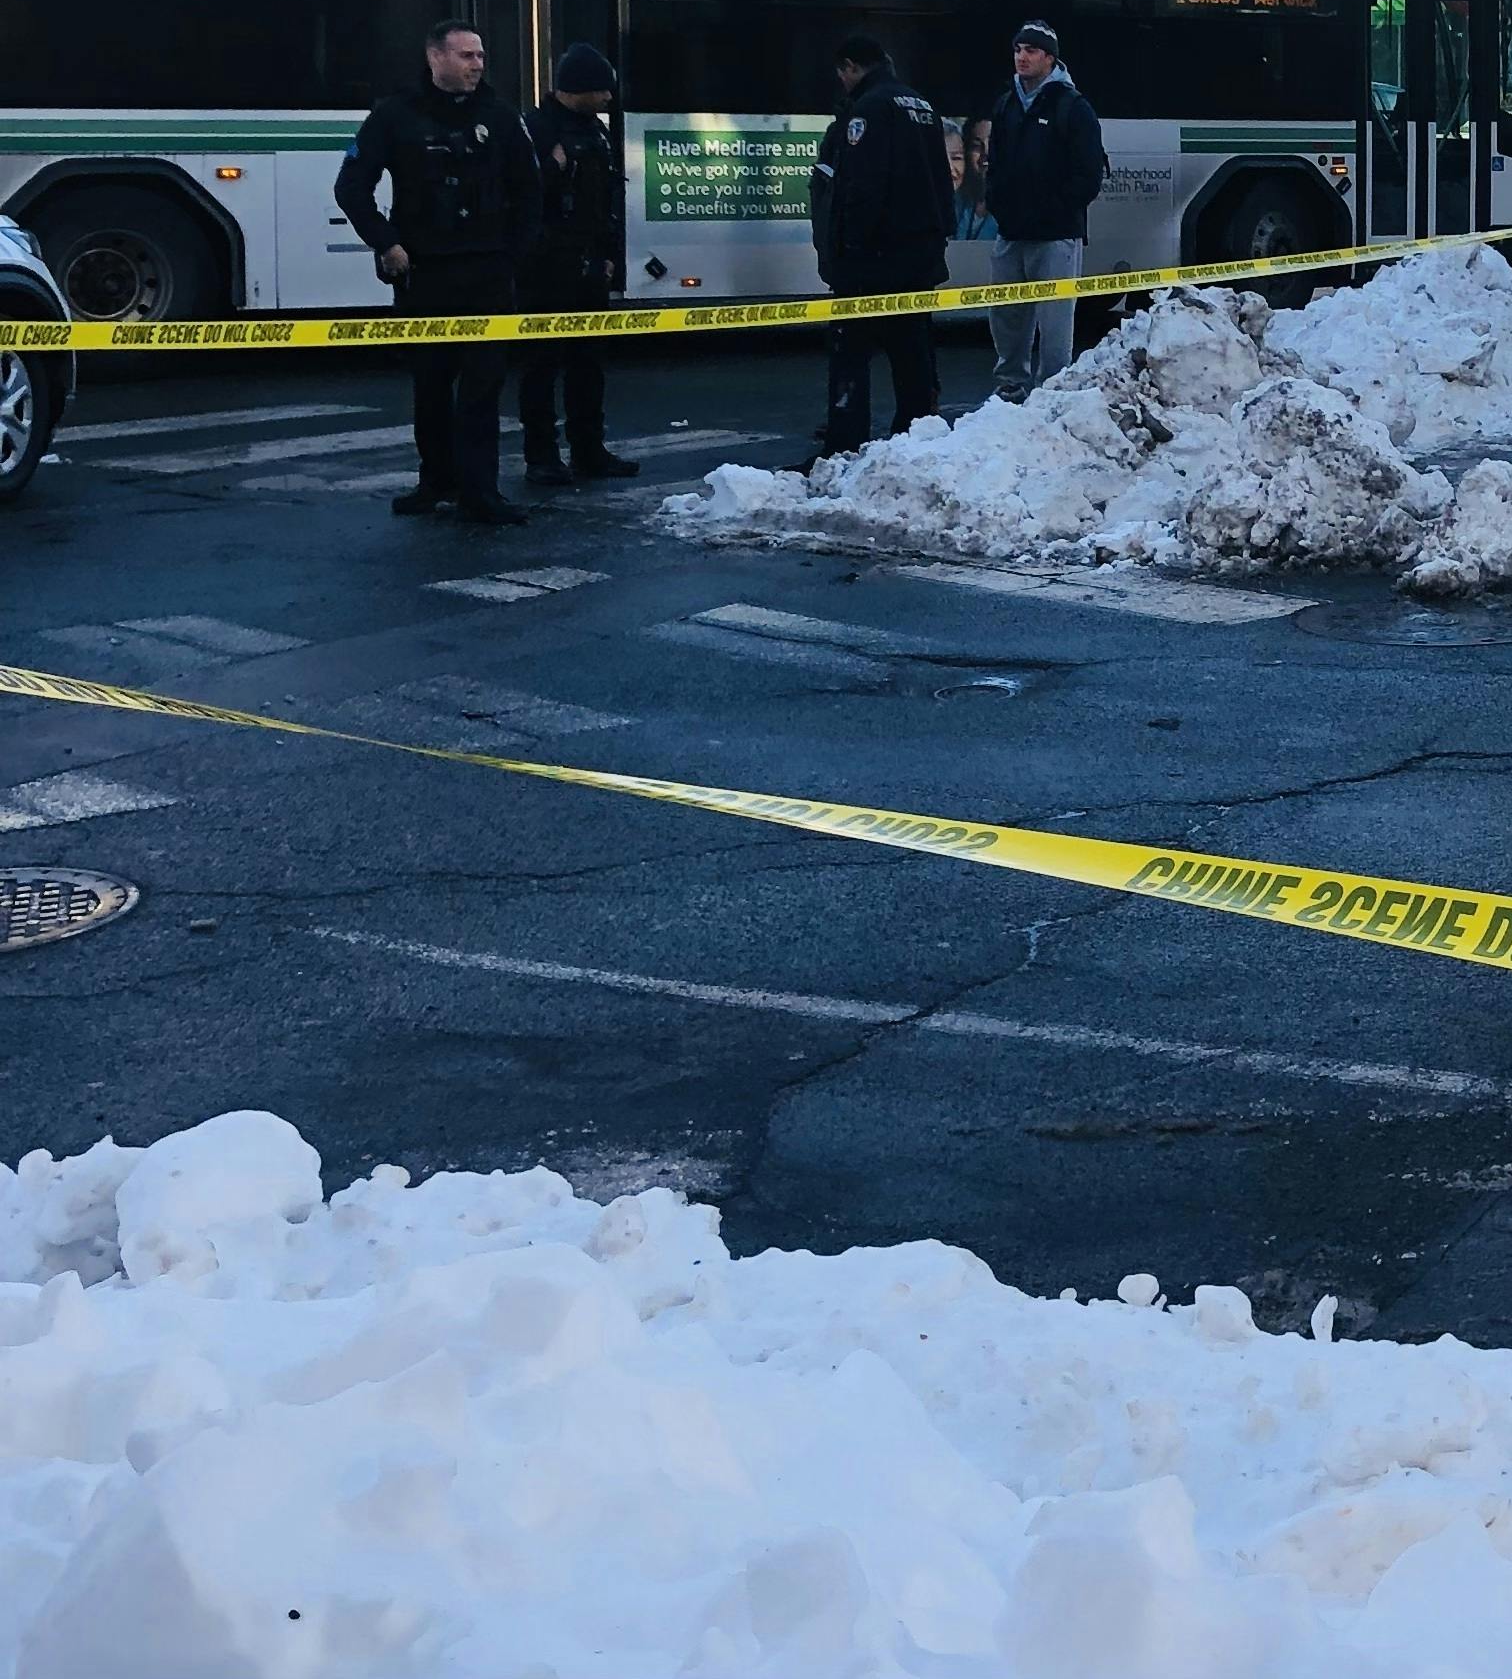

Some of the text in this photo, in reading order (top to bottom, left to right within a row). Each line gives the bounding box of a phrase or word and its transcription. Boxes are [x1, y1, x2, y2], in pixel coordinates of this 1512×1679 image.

[657, 139, 818, 157] Have Medicare and
[657, 162, 701, 177] We've
[705, 163, 729, 180] got
[732, 164, 758, 180] you
[676, 181, 783, 199] Care you need
[1100, 180, 1160, 193] ealth Plan
[676, 200, 808, 217] Benefits you want
